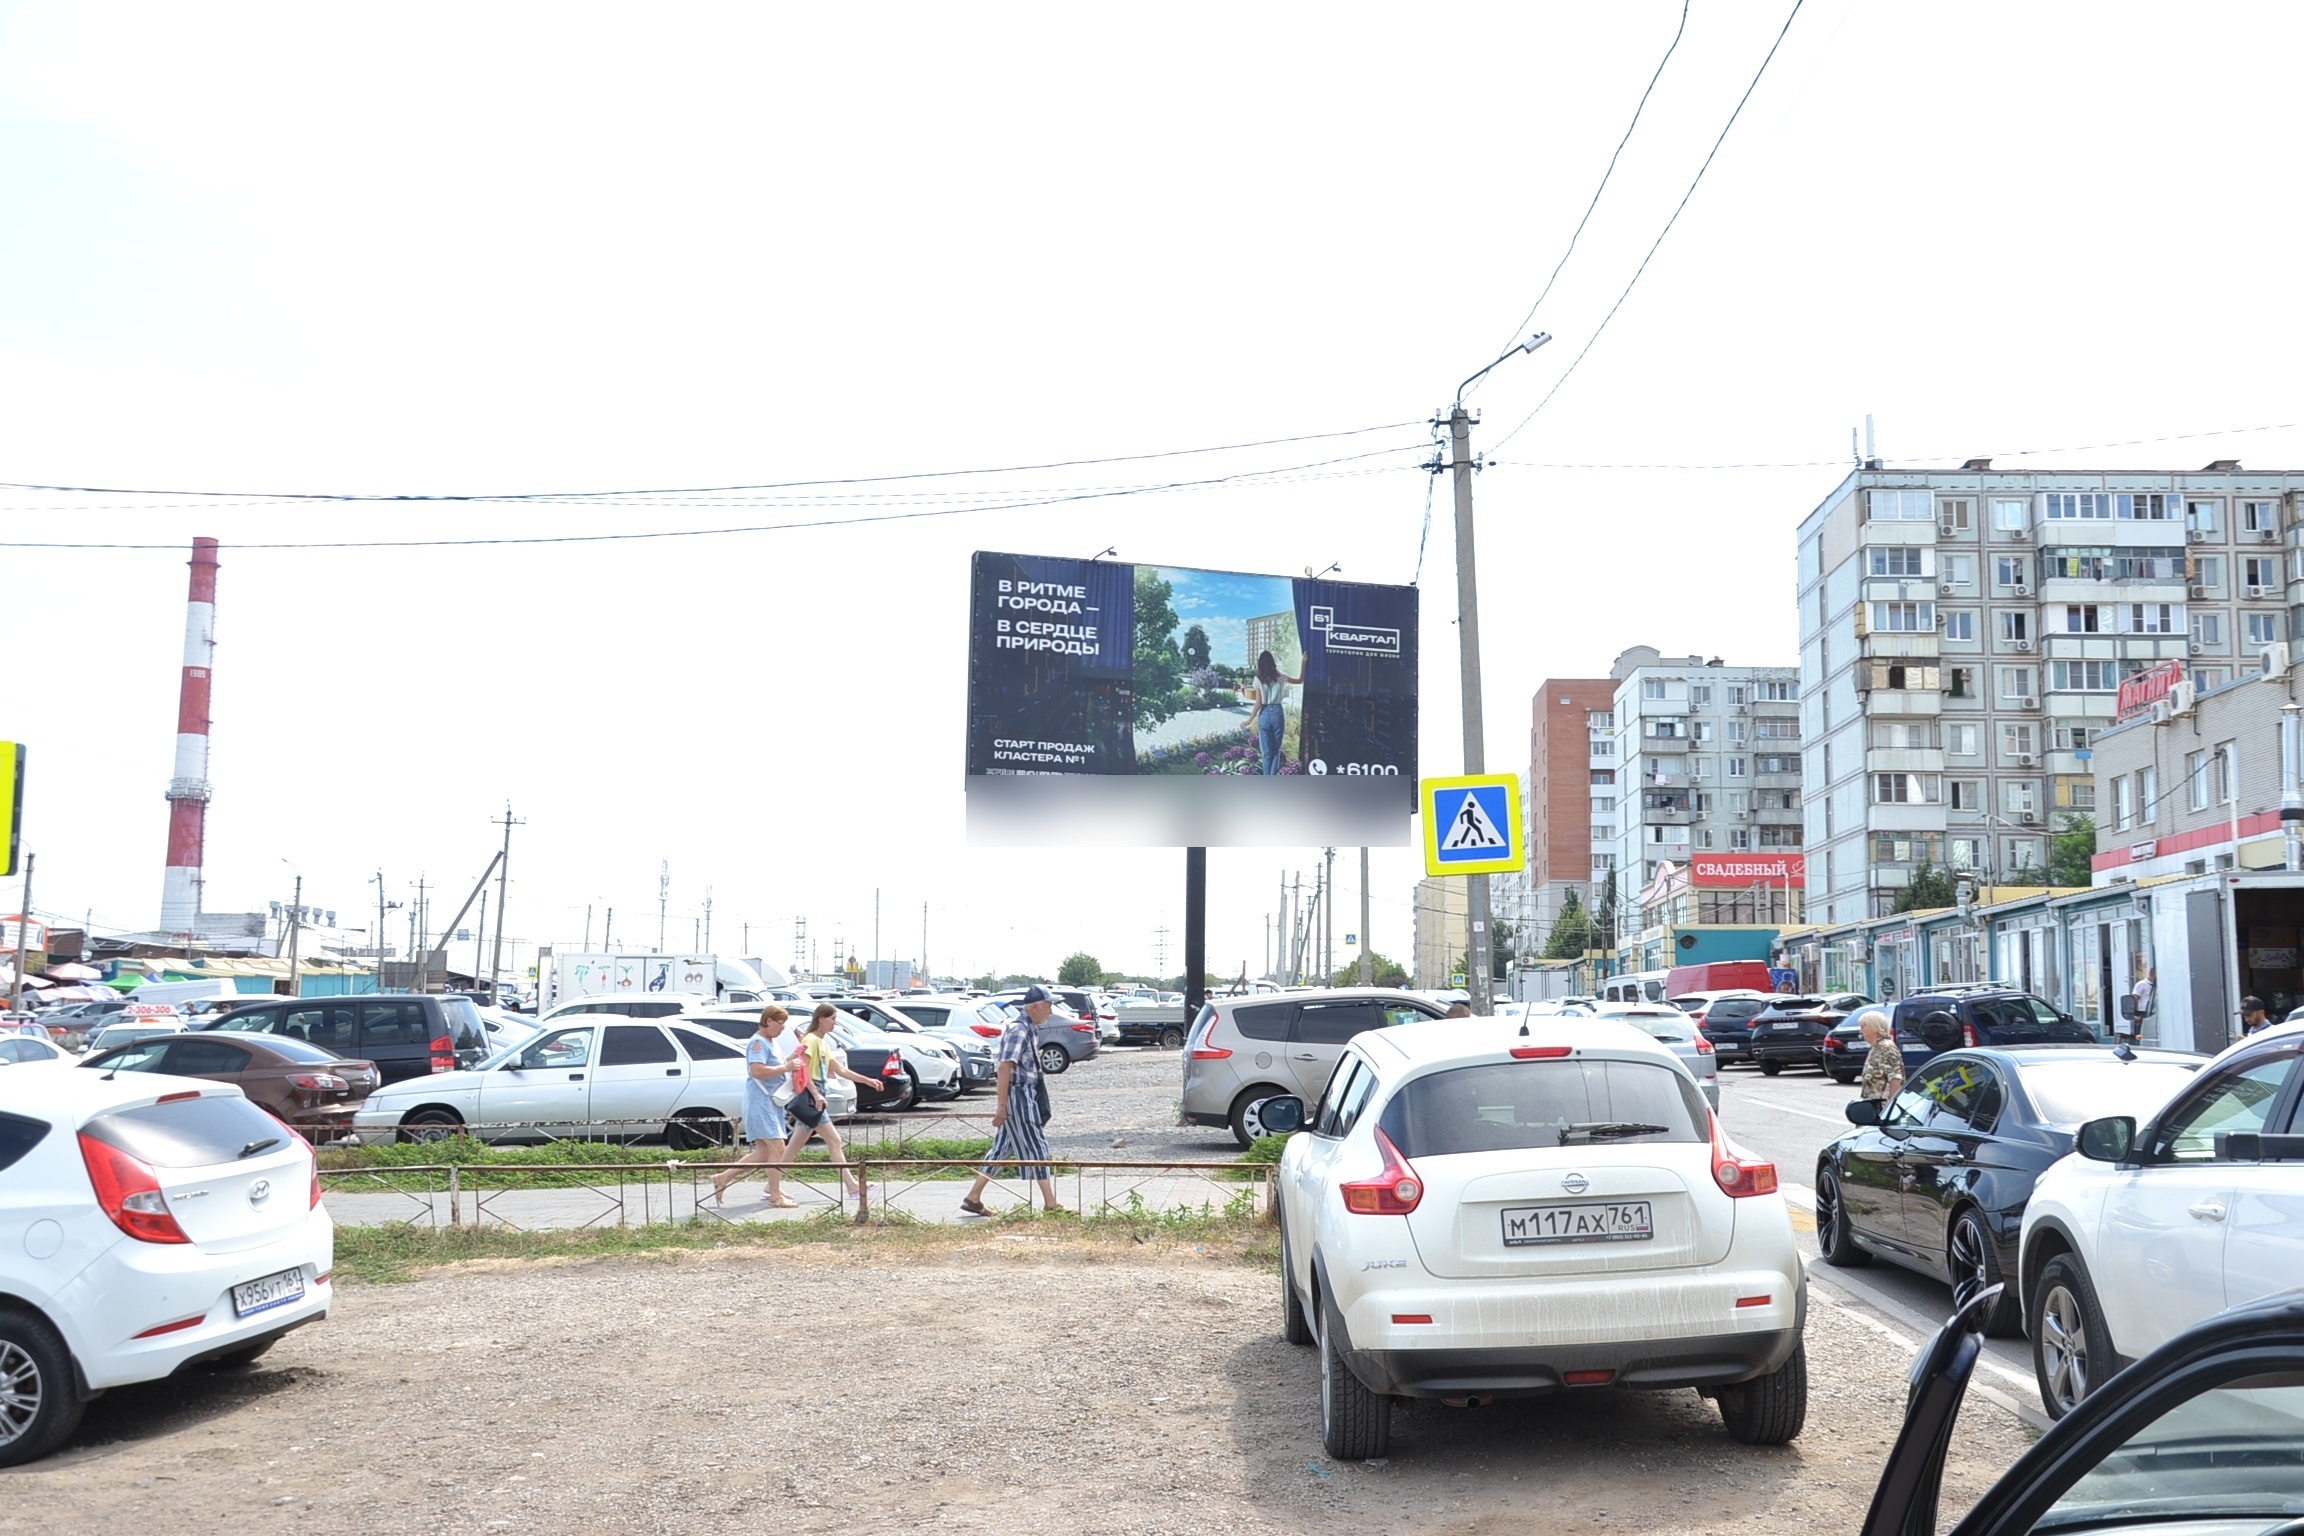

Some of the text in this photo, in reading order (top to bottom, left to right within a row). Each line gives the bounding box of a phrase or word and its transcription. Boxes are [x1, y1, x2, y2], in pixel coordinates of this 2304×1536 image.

[998, 579, 1086, 599] В РИТМЕ
[998, 595, 1082, 615] ГОРОДА
[997, 619, 1098, 640] В СЕРДЦЕ
[996, 635, 1100, 656] ПРИРОДЫ
[1329, 632, 1396, 645] КВАРТАЛ
[1326, 648, 1363, 656] ТЕРРИТОРИЯ
[993, 739, 1096, 754] СТАРТ ПРОДАЖ
[993, 751, 1063, 763] КЛАСТЕРА
[1696, 859, 1788, 877] СВАДЕБНЫЙ
[127, 1005, 171, 1014] 2-306-306
[1510, 1205, 1645, 1237] М117АХ 761
[1618, 1224, 1636, 1232] RUS
[1361, 1259, 1407, 1272] JUKE
[239, 1281, 283, 1307] Х956УТ
